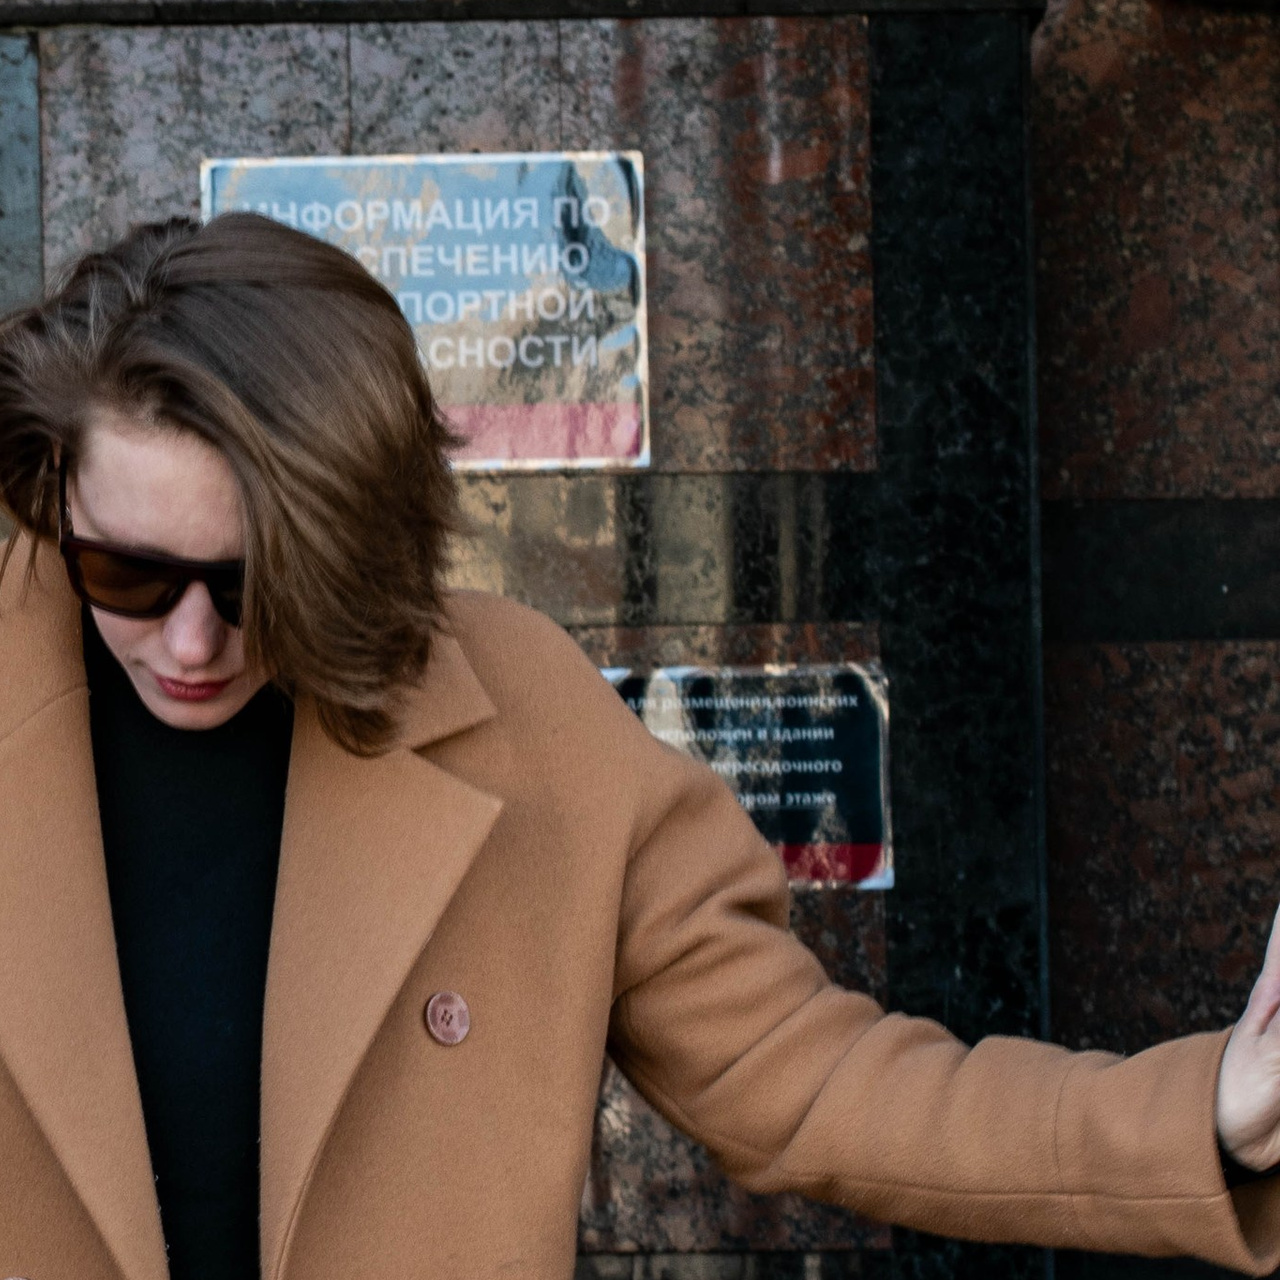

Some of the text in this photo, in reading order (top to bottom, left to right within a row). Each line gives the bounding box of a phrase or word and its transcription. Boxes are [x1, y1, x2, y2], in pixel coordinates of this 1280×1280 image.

[554, 196, 610, 229] ПО
[357, 242, 589, 277] СПЕЧЕНИЮ
[398, 283, 596, 323] ПОРТНОЙ
[416, 334, 599, 369] СНОСТИ
[736, 792, 780, 810] ором
